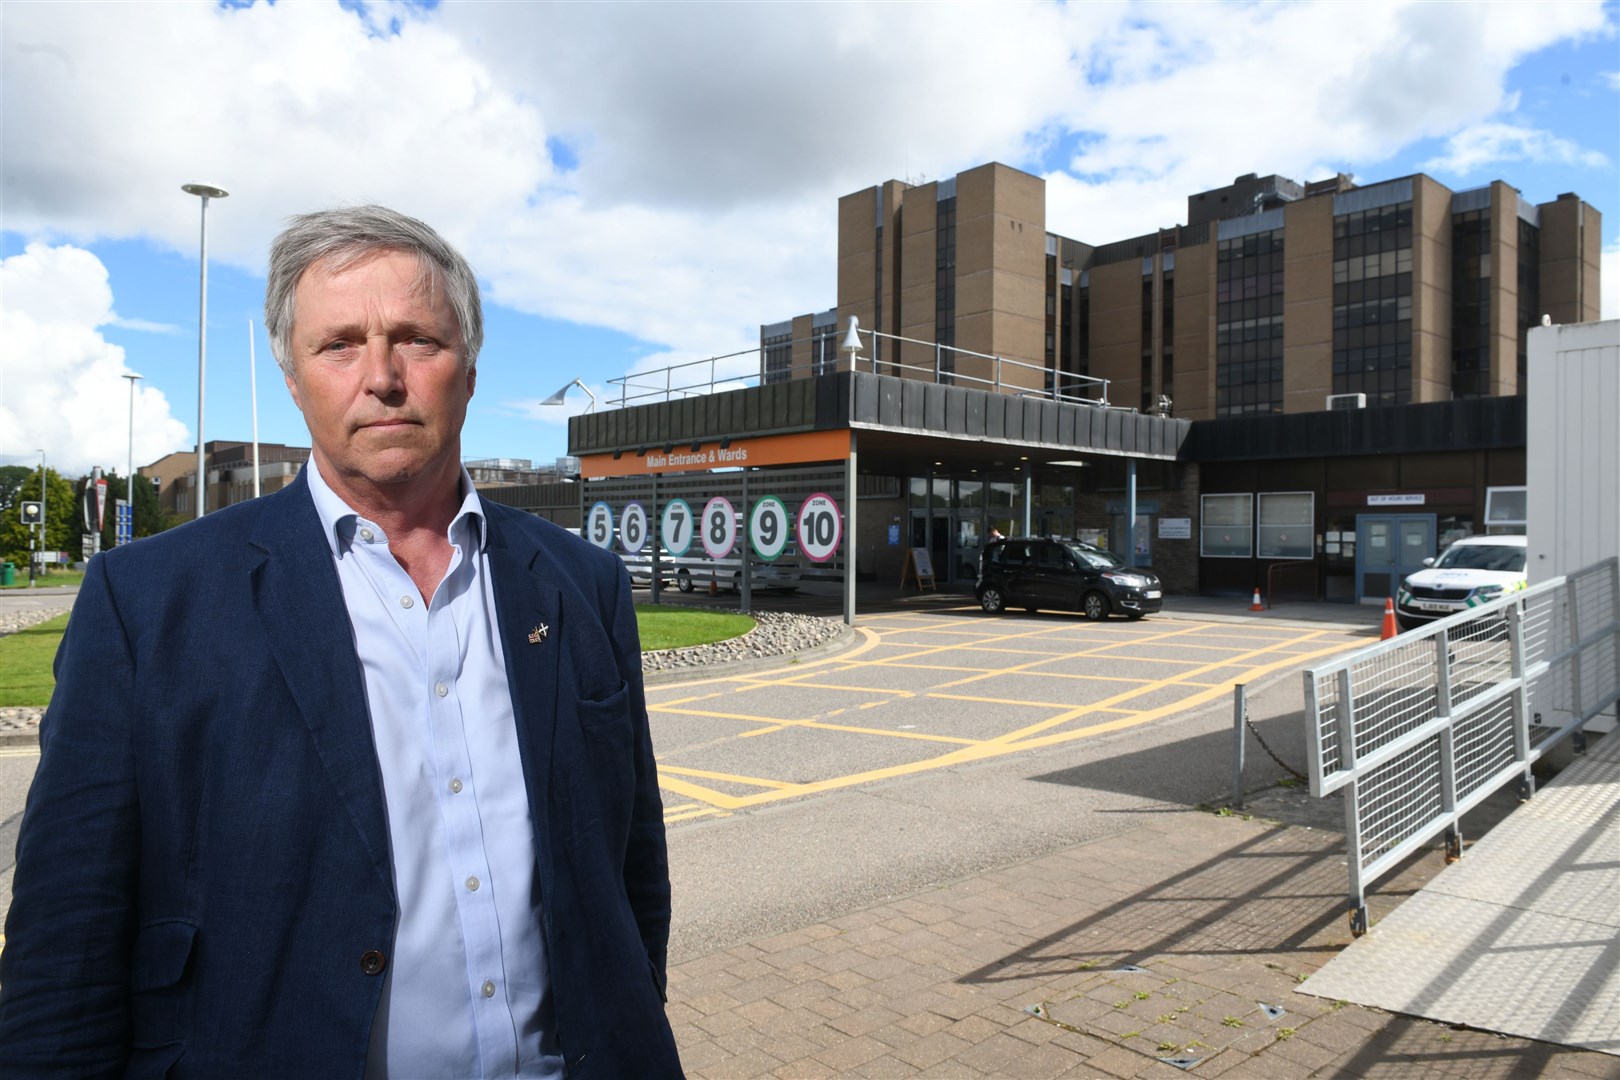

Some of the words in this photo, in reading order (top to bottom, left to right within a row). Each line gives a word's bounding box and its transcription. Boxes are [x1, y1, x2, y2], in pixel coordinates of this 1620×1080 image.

[647, 454, 666, 468] Main
[668, 453, 707, 466] Entrance
[708, 449, 715, 463] &
[718, 447, 748, 461] Wards
[594, 513, 606, 543] 5
[626, 512, 640, 543] 6
[670, 512, 684, 543] 7
[710, 510, 726, 544] 8
[760, 510, 778, 545] 9
[803, 511, 835, 546] 10
